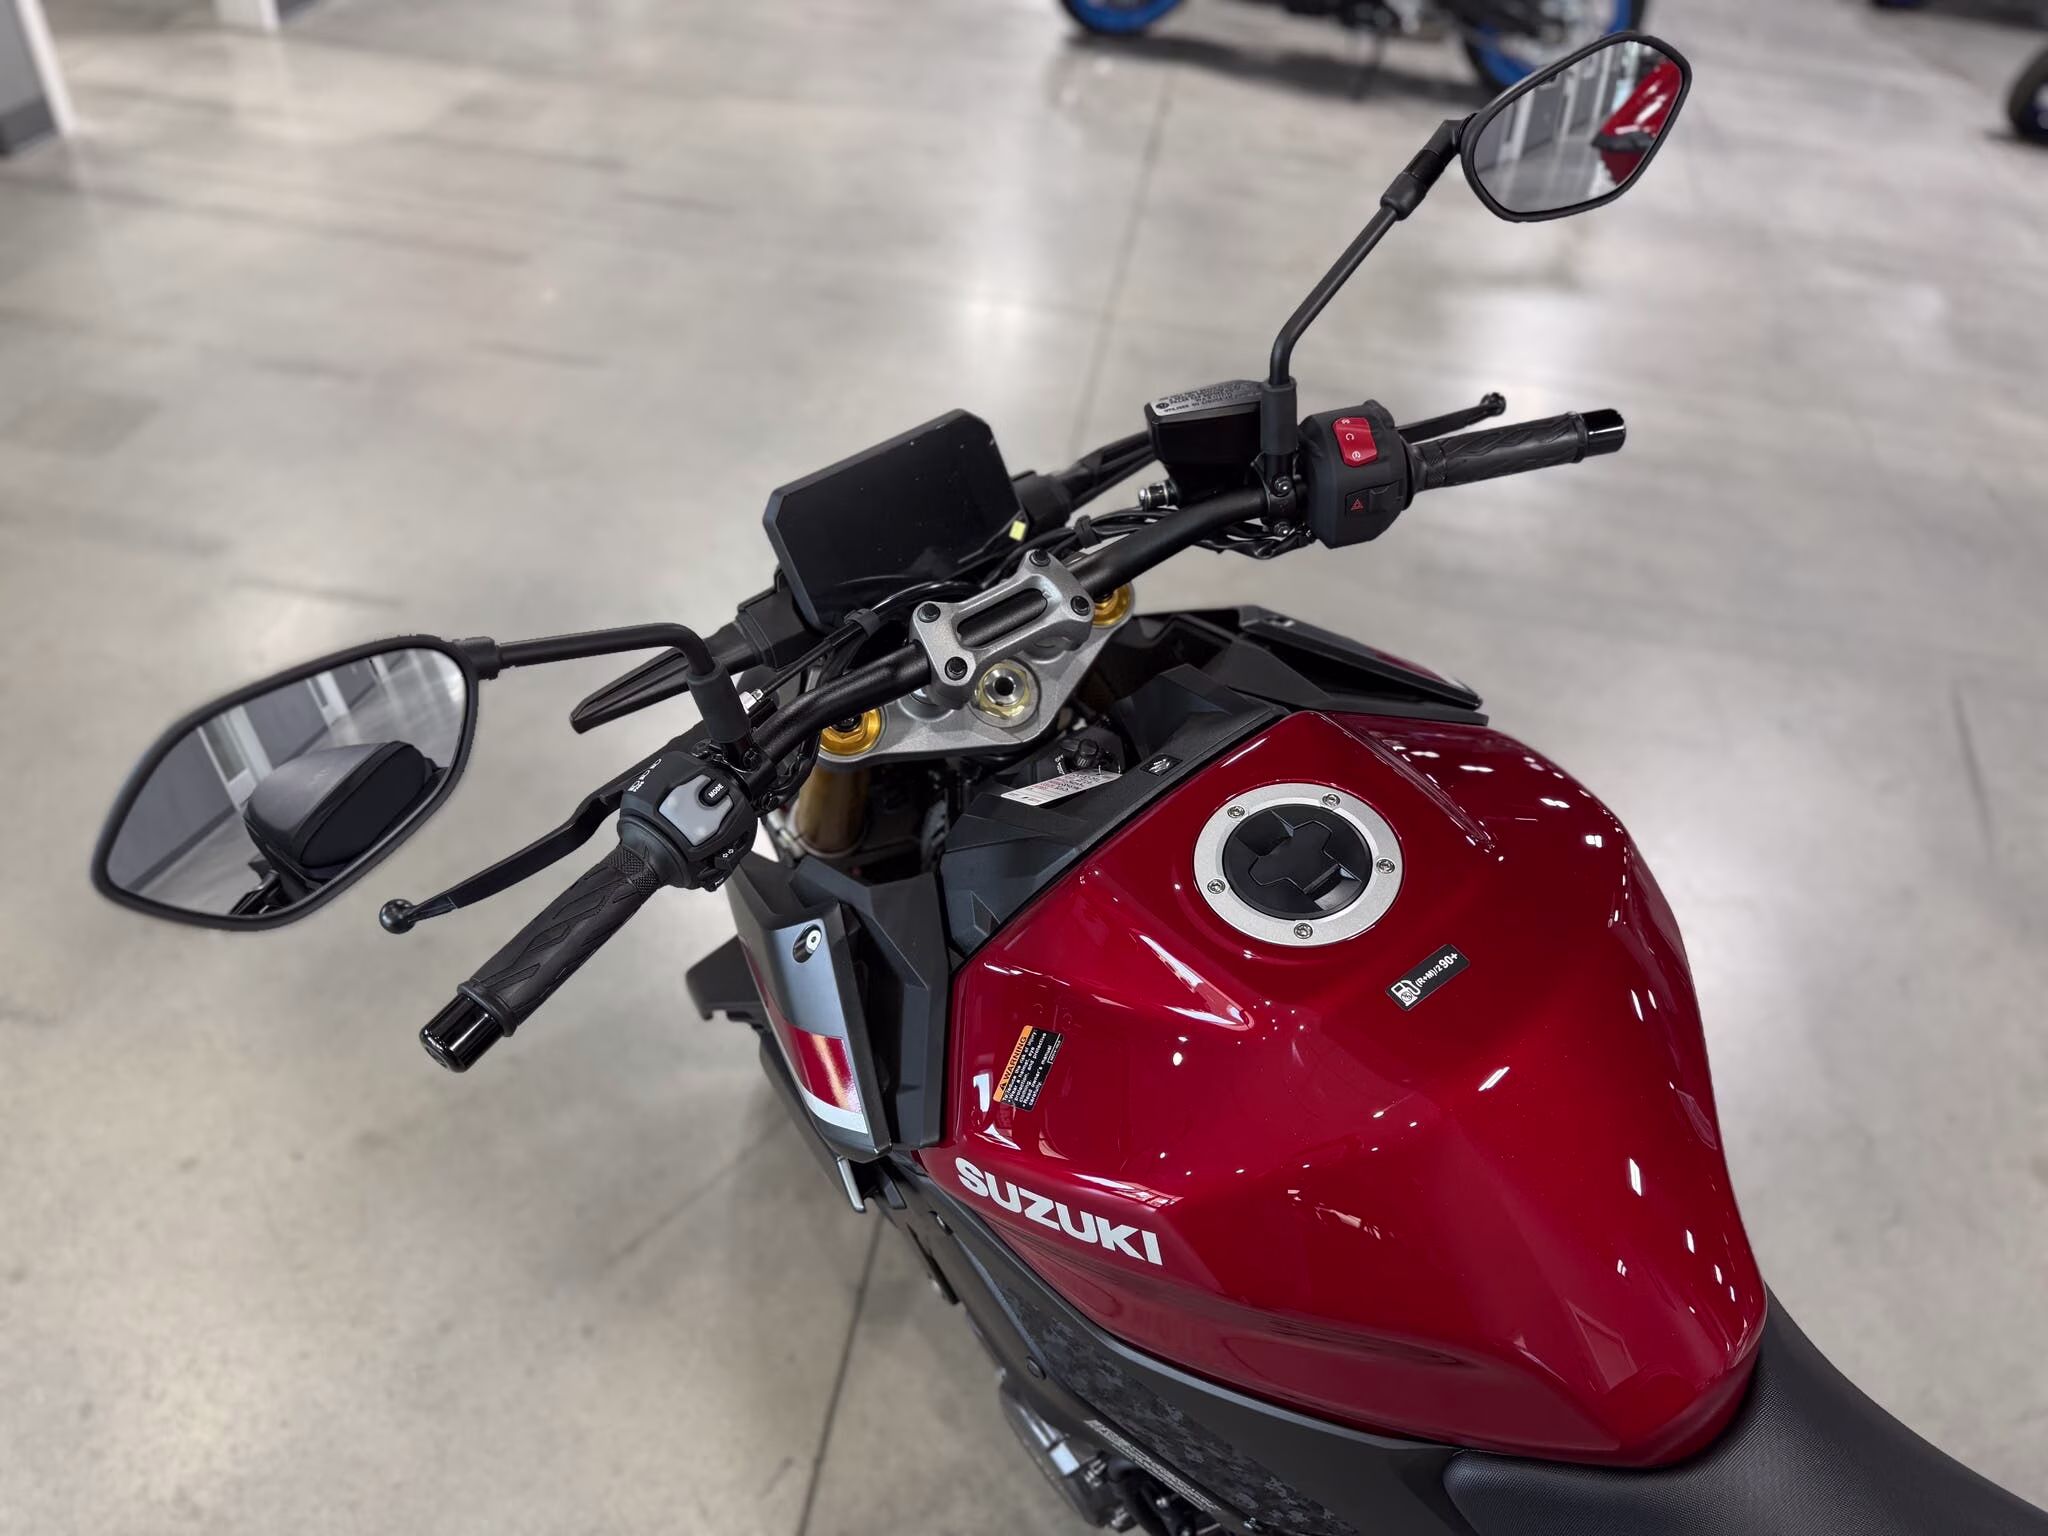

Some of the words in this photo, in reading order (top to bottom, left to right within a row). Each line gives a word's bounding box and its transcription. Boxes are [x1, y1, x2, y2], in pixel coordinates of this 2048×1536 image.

[707, 783, 724, 798] MODE
[1414, 965, 1442, 988] (R+M)/2
[1438, 953, 1458, 969] 90+
[1003, 1036, 1026, 1080] WARNING
[1032, 1033, 1046, 1059] protective
[1007, 1075, 1016, 1092] reduce
[1023, 1089, 1032, 1104] Read
[1031, 1066, 1042, 1087] owner's
[1041, 1045, 1051, 1064] manual
[1009, 1084, 1018, 1098] Wear
[955, 1157, 1163, 1266] SUZUKI
